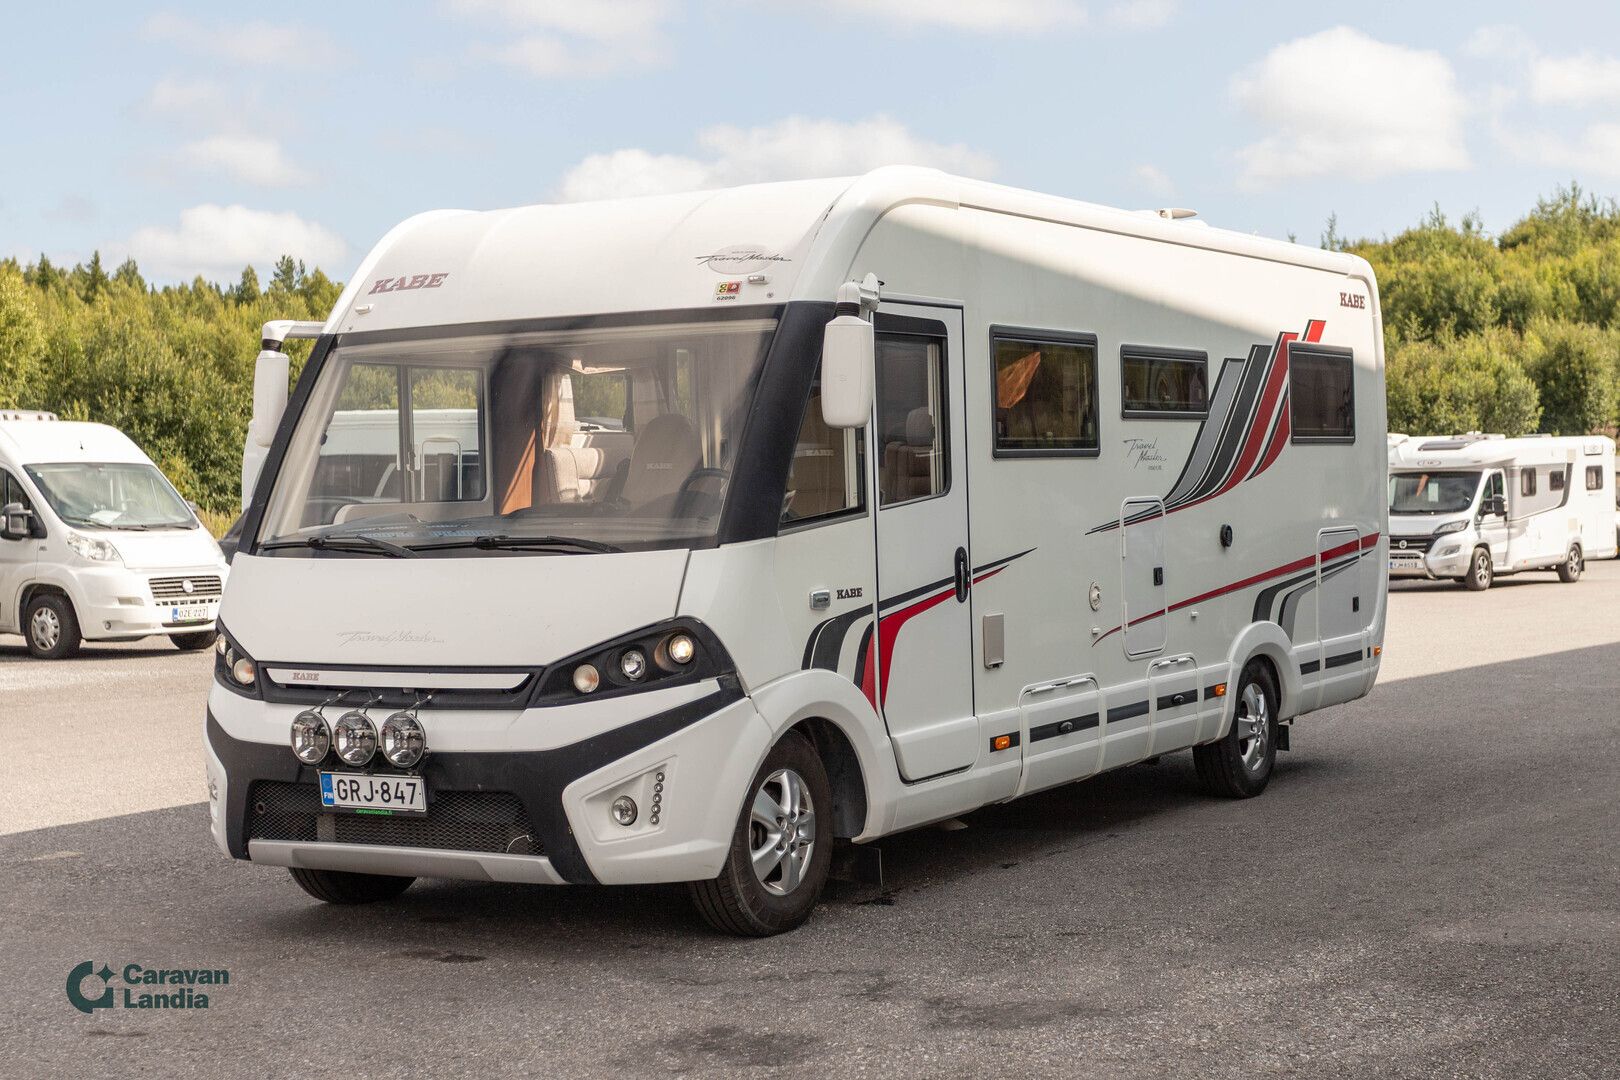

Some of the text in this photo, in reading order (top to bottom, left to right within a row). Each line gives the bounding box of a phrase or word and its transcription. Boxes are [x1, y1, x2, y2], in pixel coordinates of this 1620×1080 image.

[368, 273, 449, 295] KABE
[1340, 292, 1365, 310] KABE
[836, 588, 863, 600] KABE
[293, 672, 319, 681] KABE
[336, 779, 418, 805] GRJ-847
